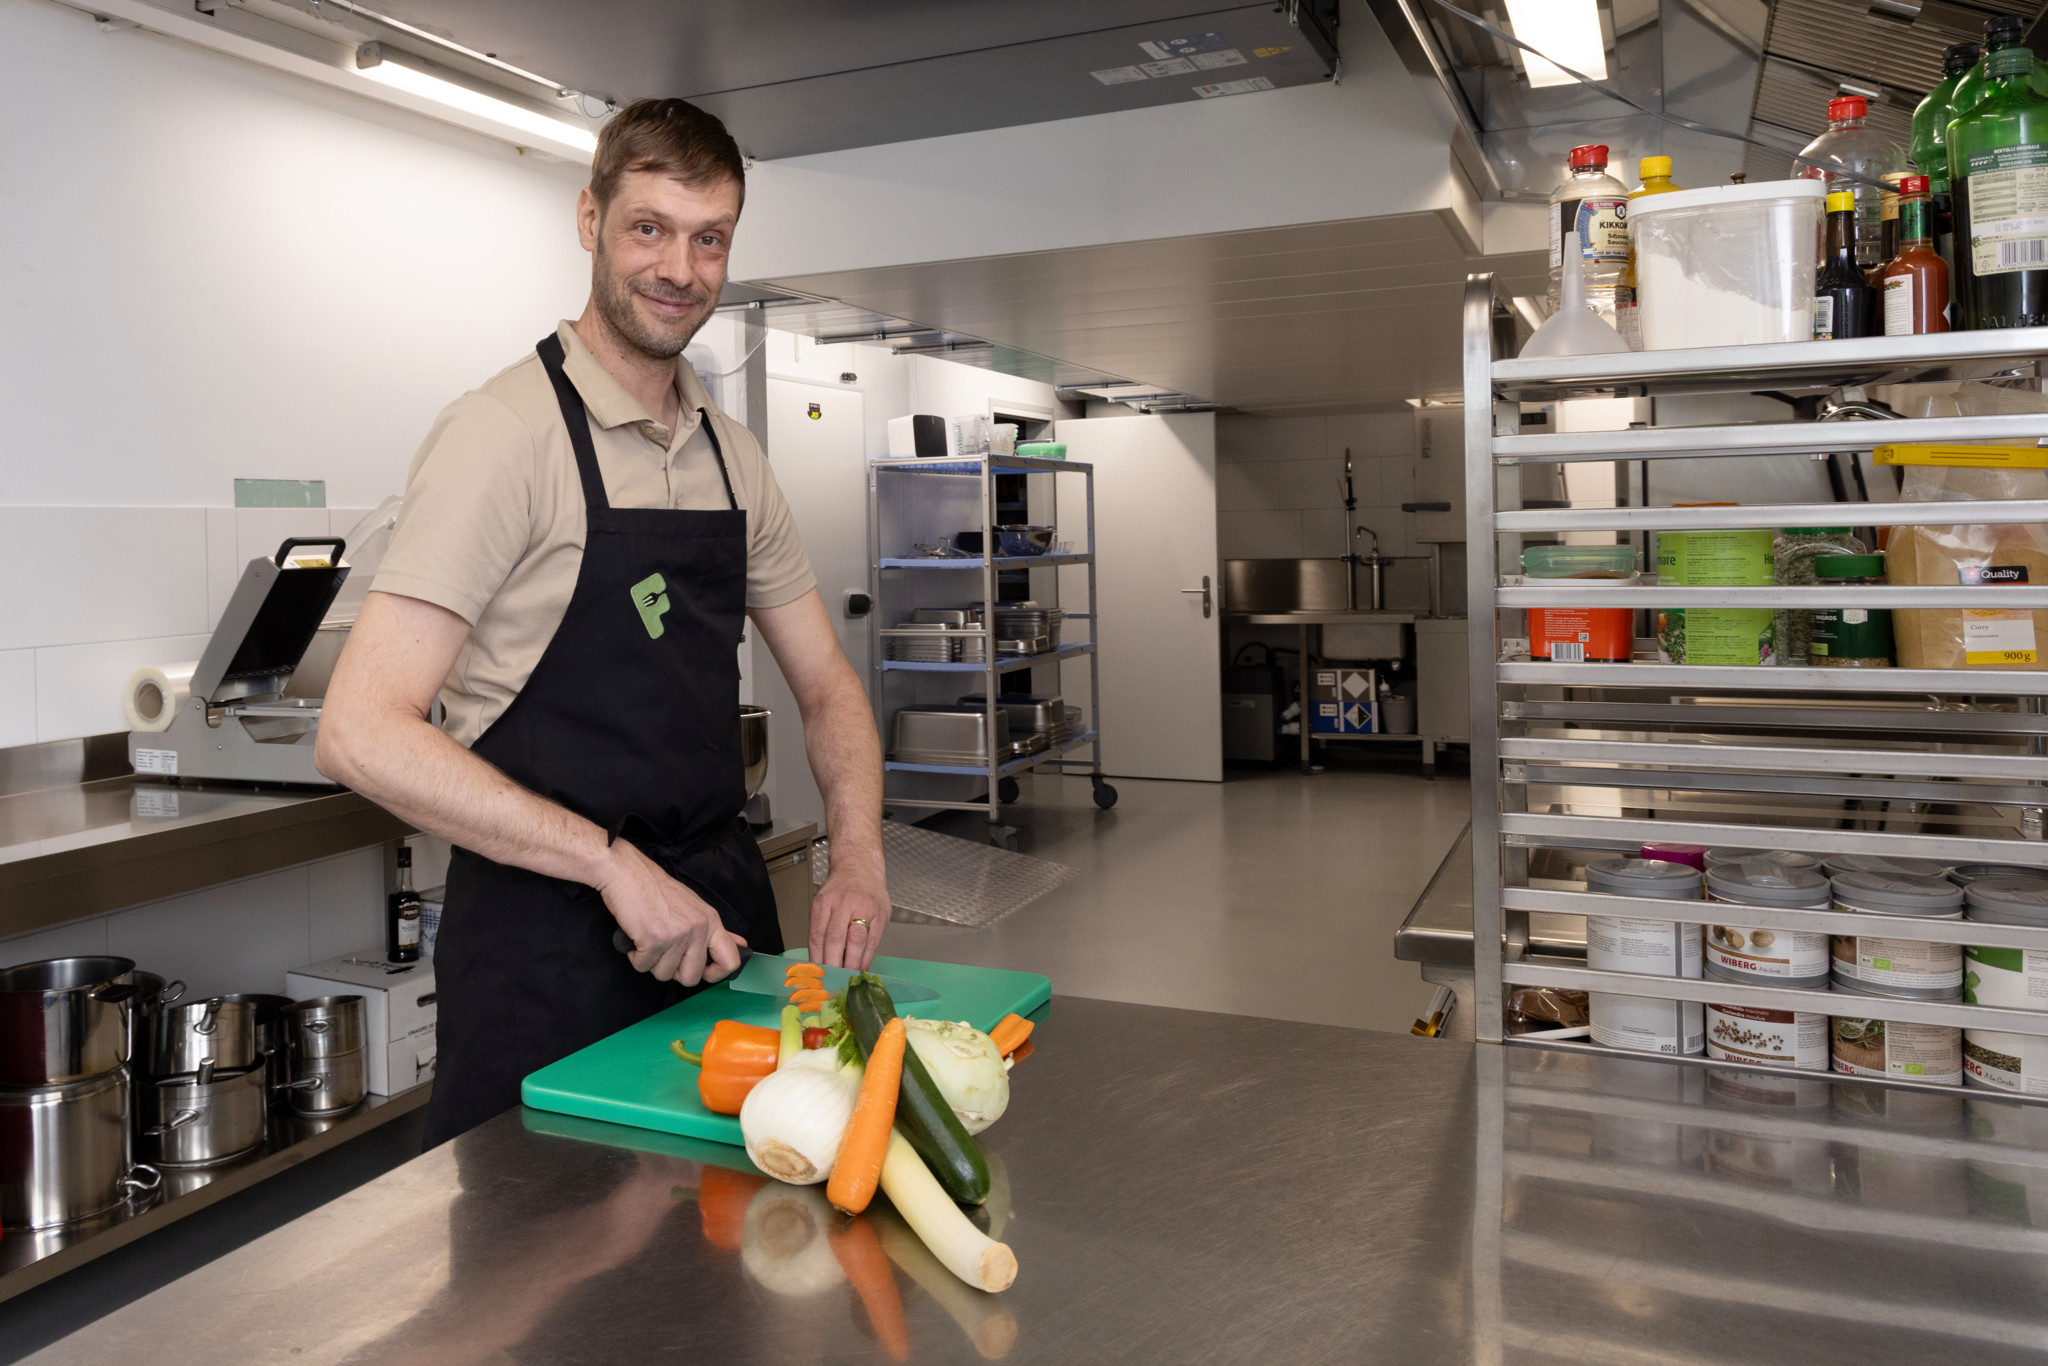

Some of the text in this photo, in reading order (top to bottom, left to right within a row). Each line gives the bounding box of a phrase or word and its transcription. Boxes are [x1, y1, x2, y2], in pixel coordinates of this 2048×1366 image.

[1981, 569, 2020, 580] Quality
[2003, 651, 2031, 662] 900 g
[1720, 955, 1757, 971] WIBERG
[1660, 1044, 1672, 1052] 600
